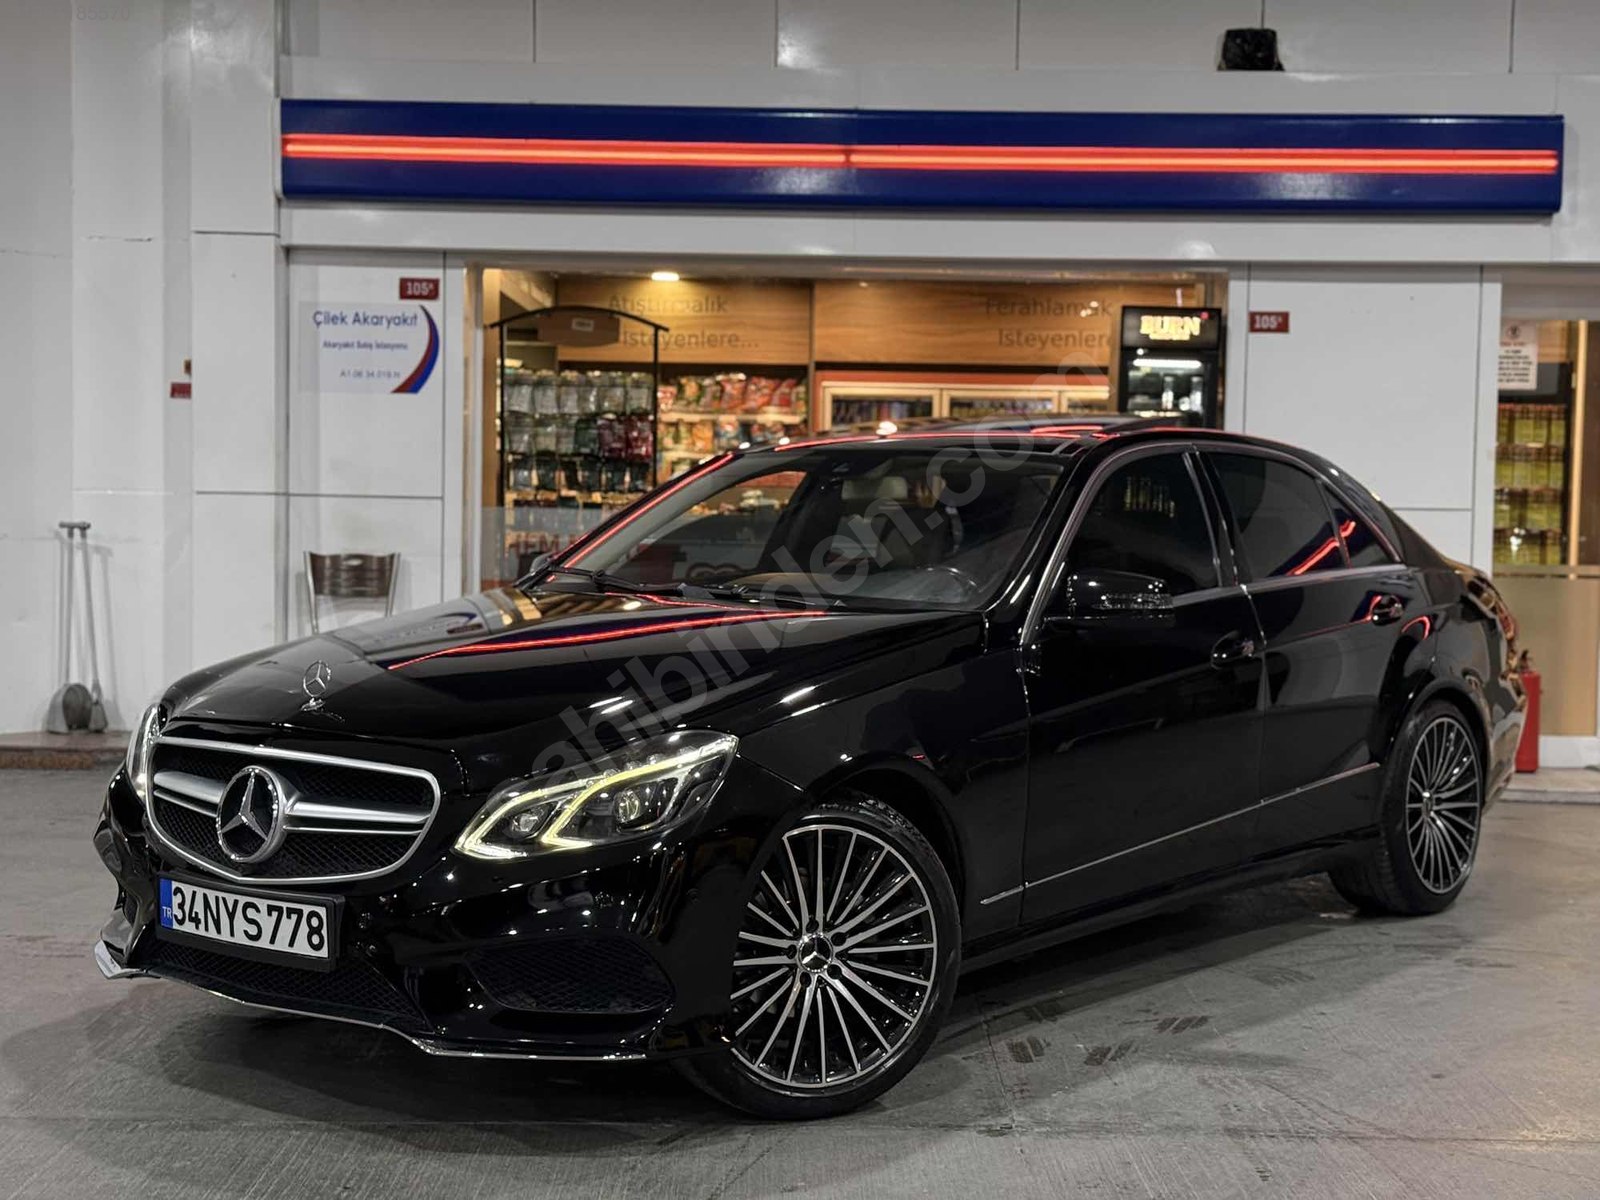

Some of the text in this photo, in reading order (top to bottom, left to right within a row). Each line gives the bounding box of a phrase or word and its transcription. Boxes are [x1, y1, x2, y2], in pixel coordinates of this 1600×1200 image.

[312, 310, 419, 331] Çilek Akaryakıt
[161, 907, 173, 919] TR
